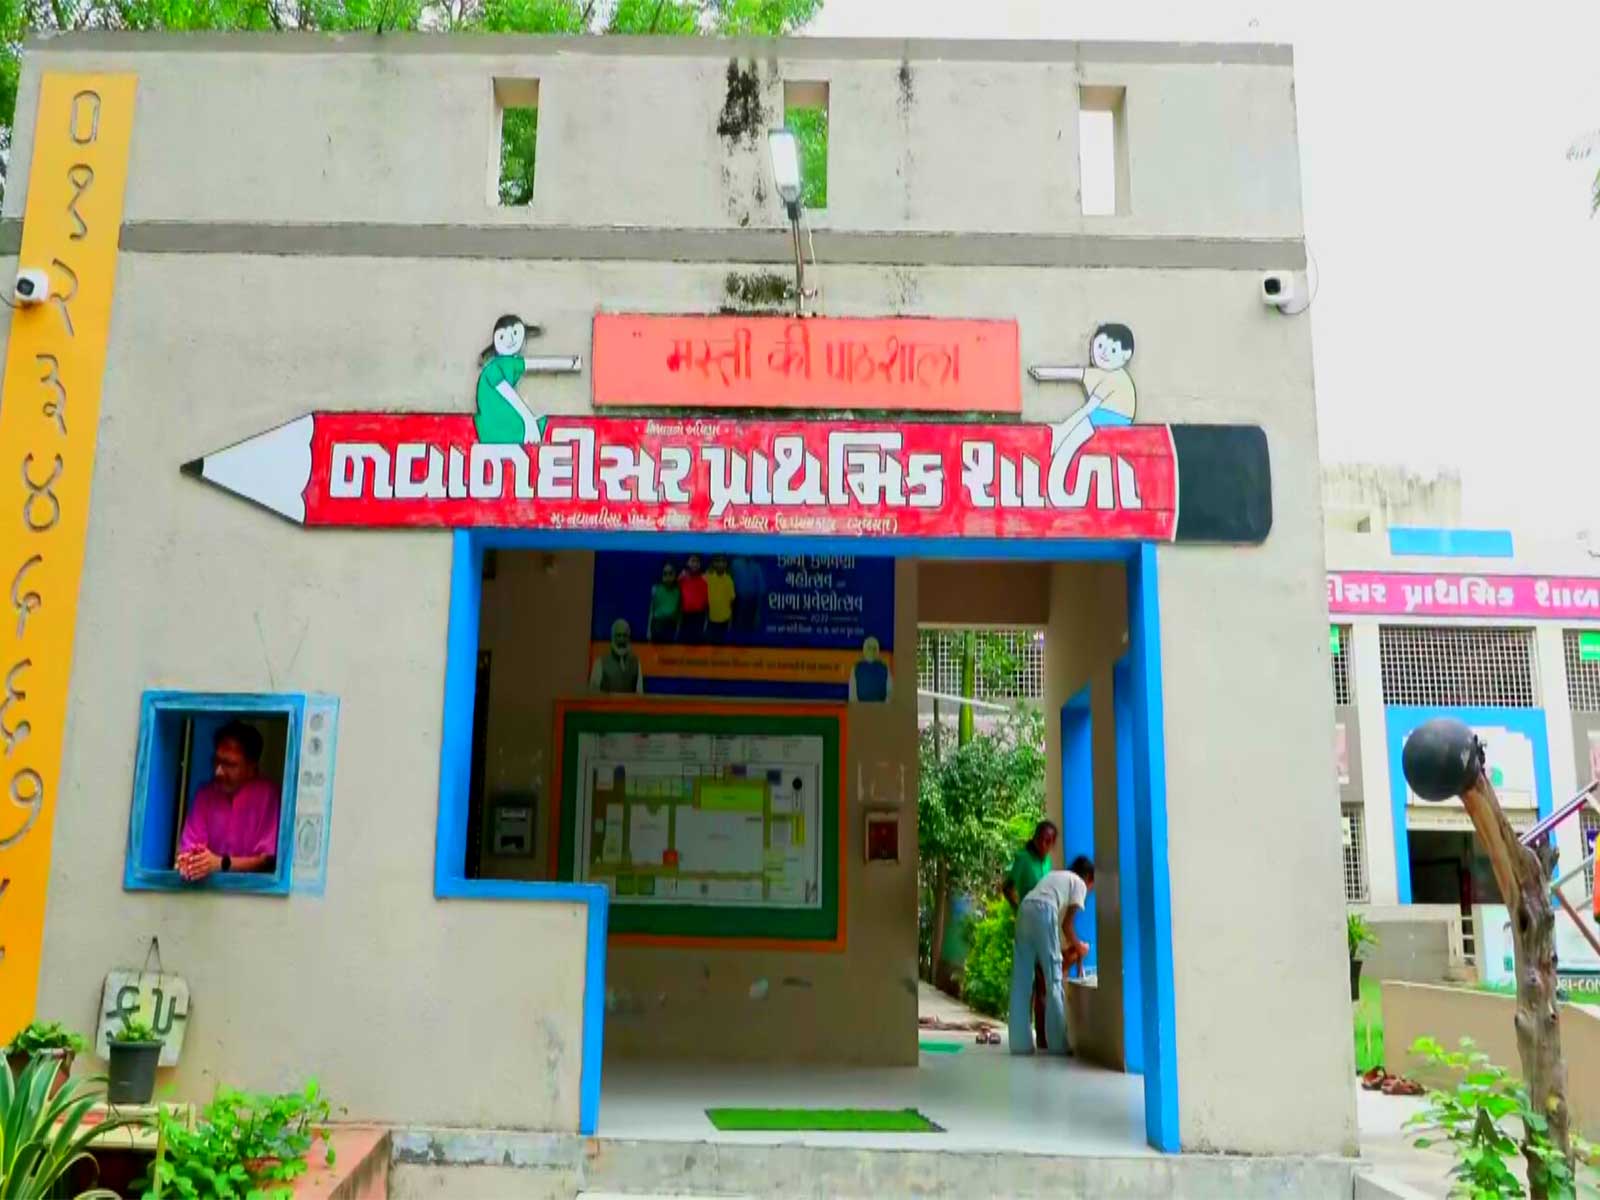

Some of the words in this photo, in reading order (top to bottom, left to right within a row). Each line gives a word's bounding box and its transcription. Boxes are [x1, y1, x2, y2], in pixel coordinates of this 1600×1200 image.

[665, 327, 752, 387] मस्ती
[767, 322, 812, 381] की
[826, 335, 960, 384] पाठशाला
[328, 426, 691, 503] નવાનદીસર
[701, 431, 943, 517] પ્રાથમિક
[960, 420, 1143, 510] શાળા
[1401, 577, 1515, 613] પ્રાથમિક
